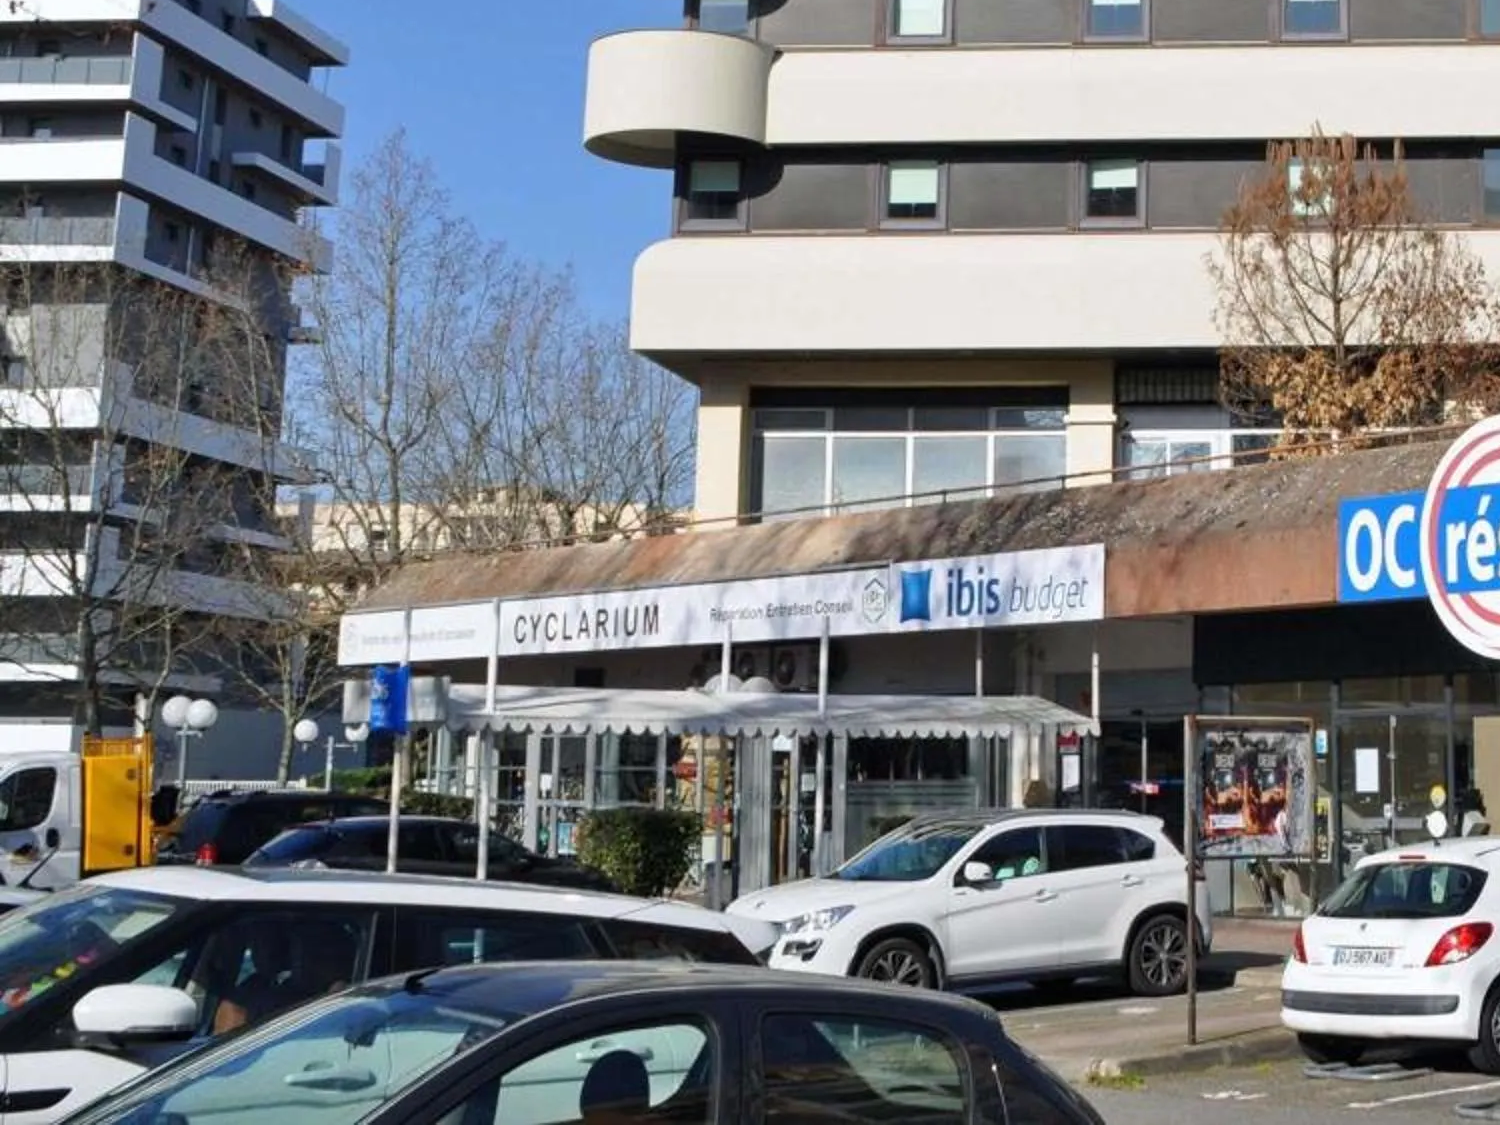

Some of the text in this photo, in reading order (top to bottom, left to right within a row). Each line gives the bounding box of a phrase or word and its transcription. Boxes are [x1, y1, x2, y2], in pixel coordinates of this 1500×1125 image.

[1345, 504, 1416, 592] OC
[946, 566, 1089, 619] ibis budget
[513, 602, 660, 644] CYCLARIUM
